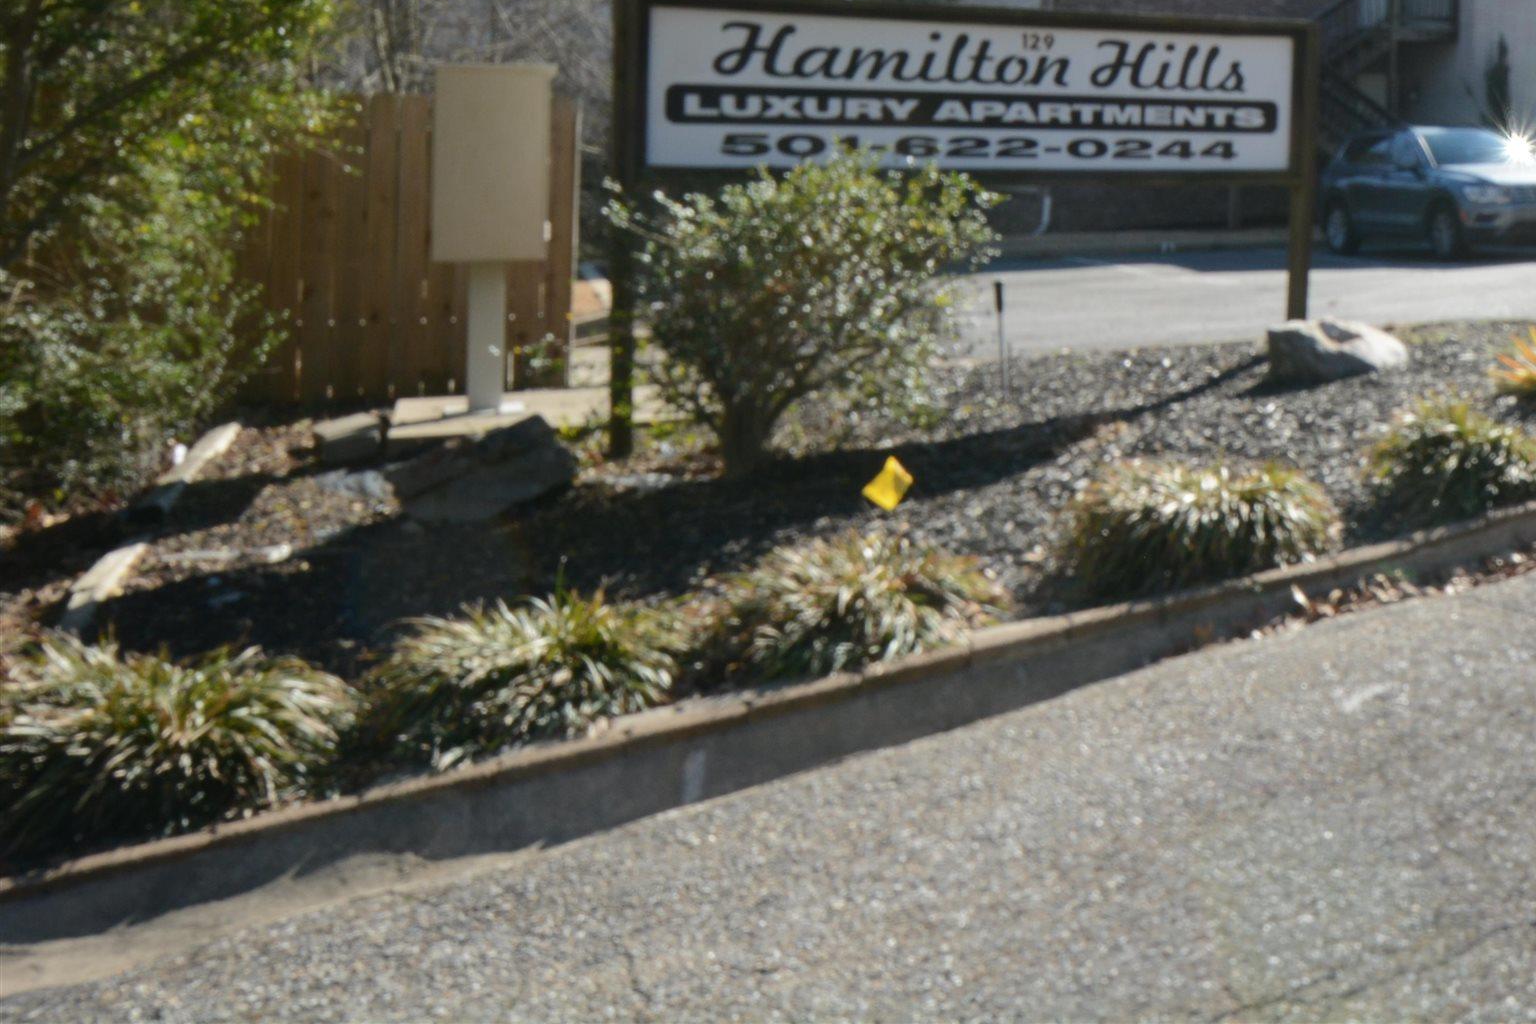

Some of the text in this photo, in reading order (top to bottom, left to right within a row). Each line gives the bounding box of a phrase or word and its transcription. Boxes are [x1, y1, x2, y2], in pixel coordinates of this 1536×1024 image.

[712, 21, 1245, 93] Hamilton Hills
[1022, 33, 1054, 51] 129
[683, 92, 1266, 128] LUXURY APARTMENTS
[720, 133, 1237, 160] 501-622-0244
